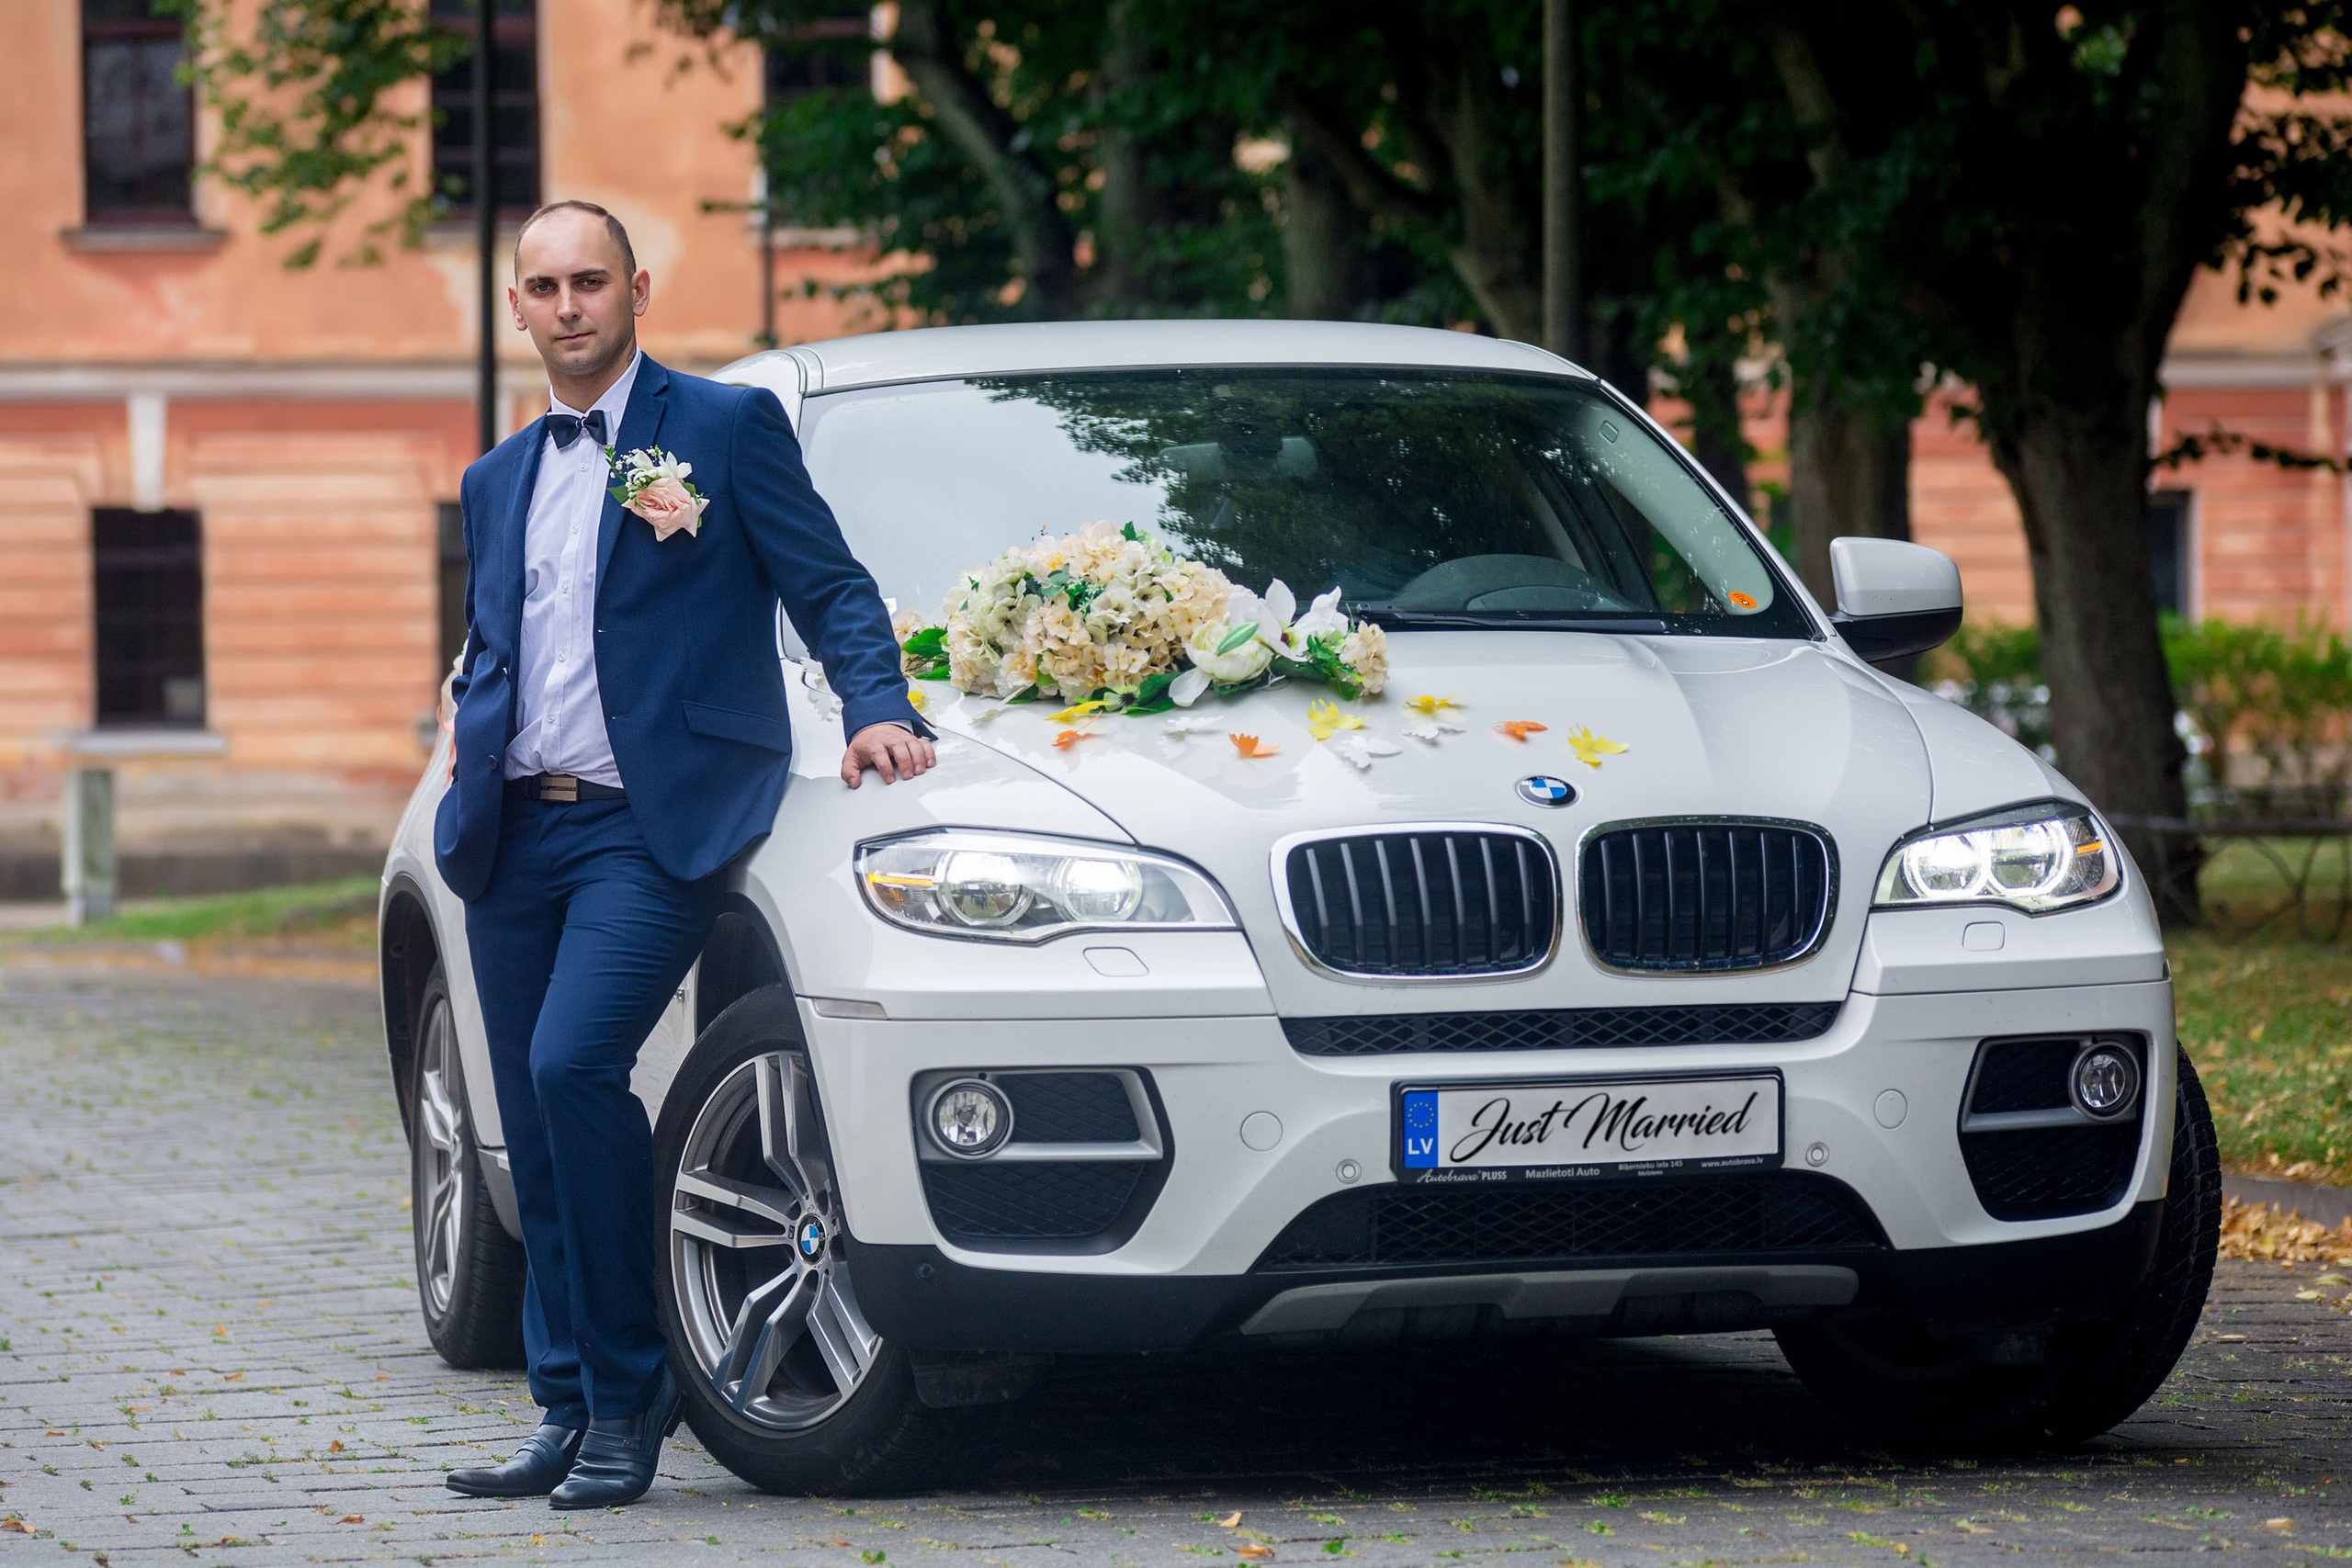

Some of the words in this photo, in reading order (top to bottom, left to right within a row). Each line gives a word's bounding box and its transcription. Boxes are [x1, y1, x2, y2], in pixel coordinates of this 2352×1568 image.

[1450, 1098, 1570, 1163] Just
[1564, 1091, 1758, 1152] Married
[1408, 1138, 1433, 1155] LV
[1701, 1156, 1764, 1168] www.autobrava.lv
[1417, 1168, 1478, 1183] Autobrava
[1481, 1170, 1507, 1180] PLUSS
[1525, 1168, 1574, 1179] Mazlietoti
[1577, 1167, 1600, 1177] Auto
